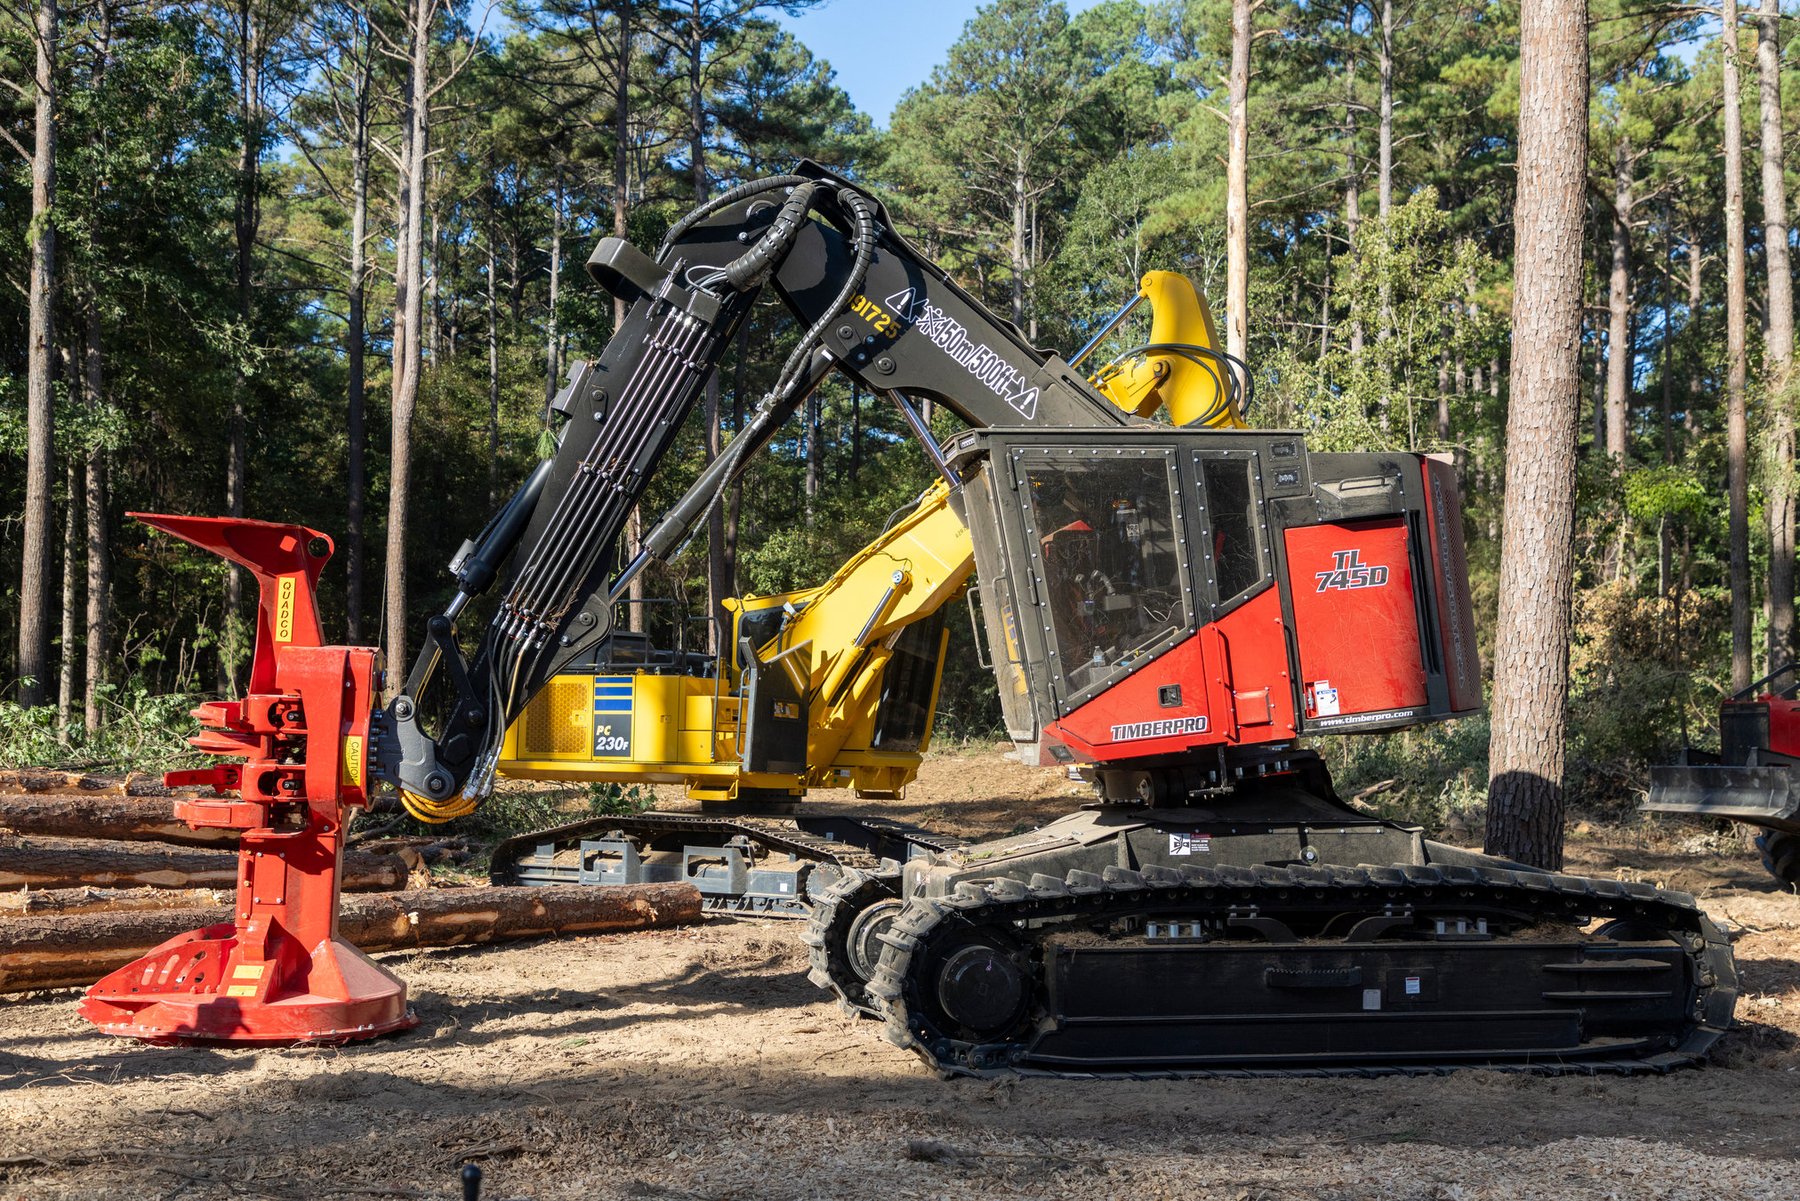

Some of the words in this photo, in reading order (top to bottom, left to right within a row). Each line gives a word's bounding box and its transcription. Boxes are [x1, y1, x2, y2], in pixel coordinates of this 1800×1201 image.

[847, 290, 902, 338] 91725
[1332, 549, 1366, 571] TL
[1315, 565, 1389, 592] 745D
[279, 581, 292, 638] QUADCO
[596, 725, 611, 736] PC
[1111, 715, 1207, 741] TIMBERPRO
[1320, 710, 1414, 727] www.timberpro.com
